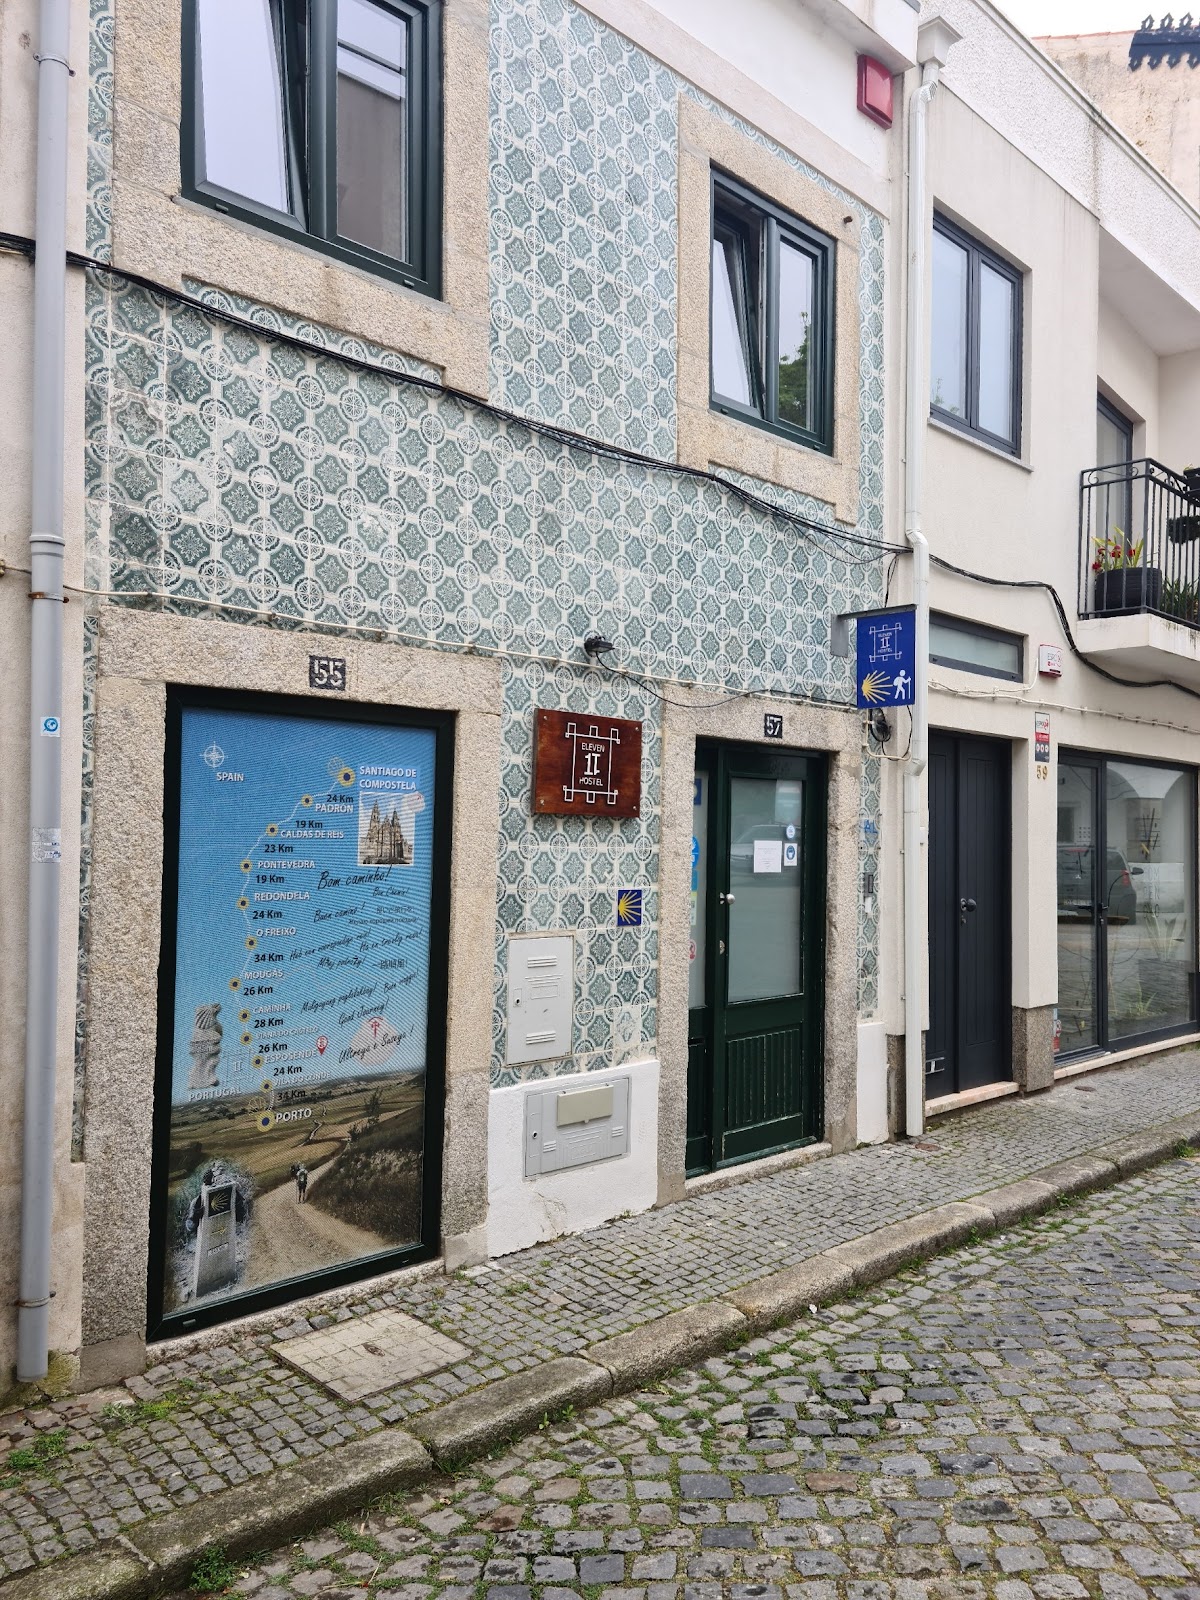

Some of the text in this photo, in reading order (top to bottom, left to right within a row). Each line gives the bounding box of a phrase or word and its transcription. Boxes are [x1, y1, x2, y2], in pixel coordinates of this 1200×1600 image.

[314, 659, 344, 687] 55
[766, 716, 782, 736] 57
[581, 742, 606, 753] ELEVEN
[216, 772, 245, 782] SPAIN
[359, 766, 417, 778] SANTIAGO DE
[1036, 765, 1048, 780] 59
[359, 779, 417, 791] COMPOSTELA
[579, 777, 604, 787] HOSTEL
[326, 794, 354, 803] 24 Km
[295, 820, 323, 829] 19 Km
[280, 830, 344, 839] CALDAS DE REIS
[264, 844, 294, 853] 23 Km
[258, 860, 316, 870] PONTEVEDRA
[256, 875, 285, 884] 19 Km
[317, 870, 341, 890] Bom
[254, 890, 310, 901] REDONDELA
[252, 910, 283, 920] 24 Km
[256, 926, 296, 937] O FREIXO
[254, 953, 284, 963] 34 Km
[243, 985, 273, 996] 26 Km
[254, 1017, 284, 1029] 28 Km
[258, 1043, 288, 1054] 26 Km
[273, 1065, 302, 1077] 24 Km
[188, 1086, 242, 1101] PORTUGAL
[291, 1090, 306, 1099] Km
[275, 1107, 312, 1123] PORTO
